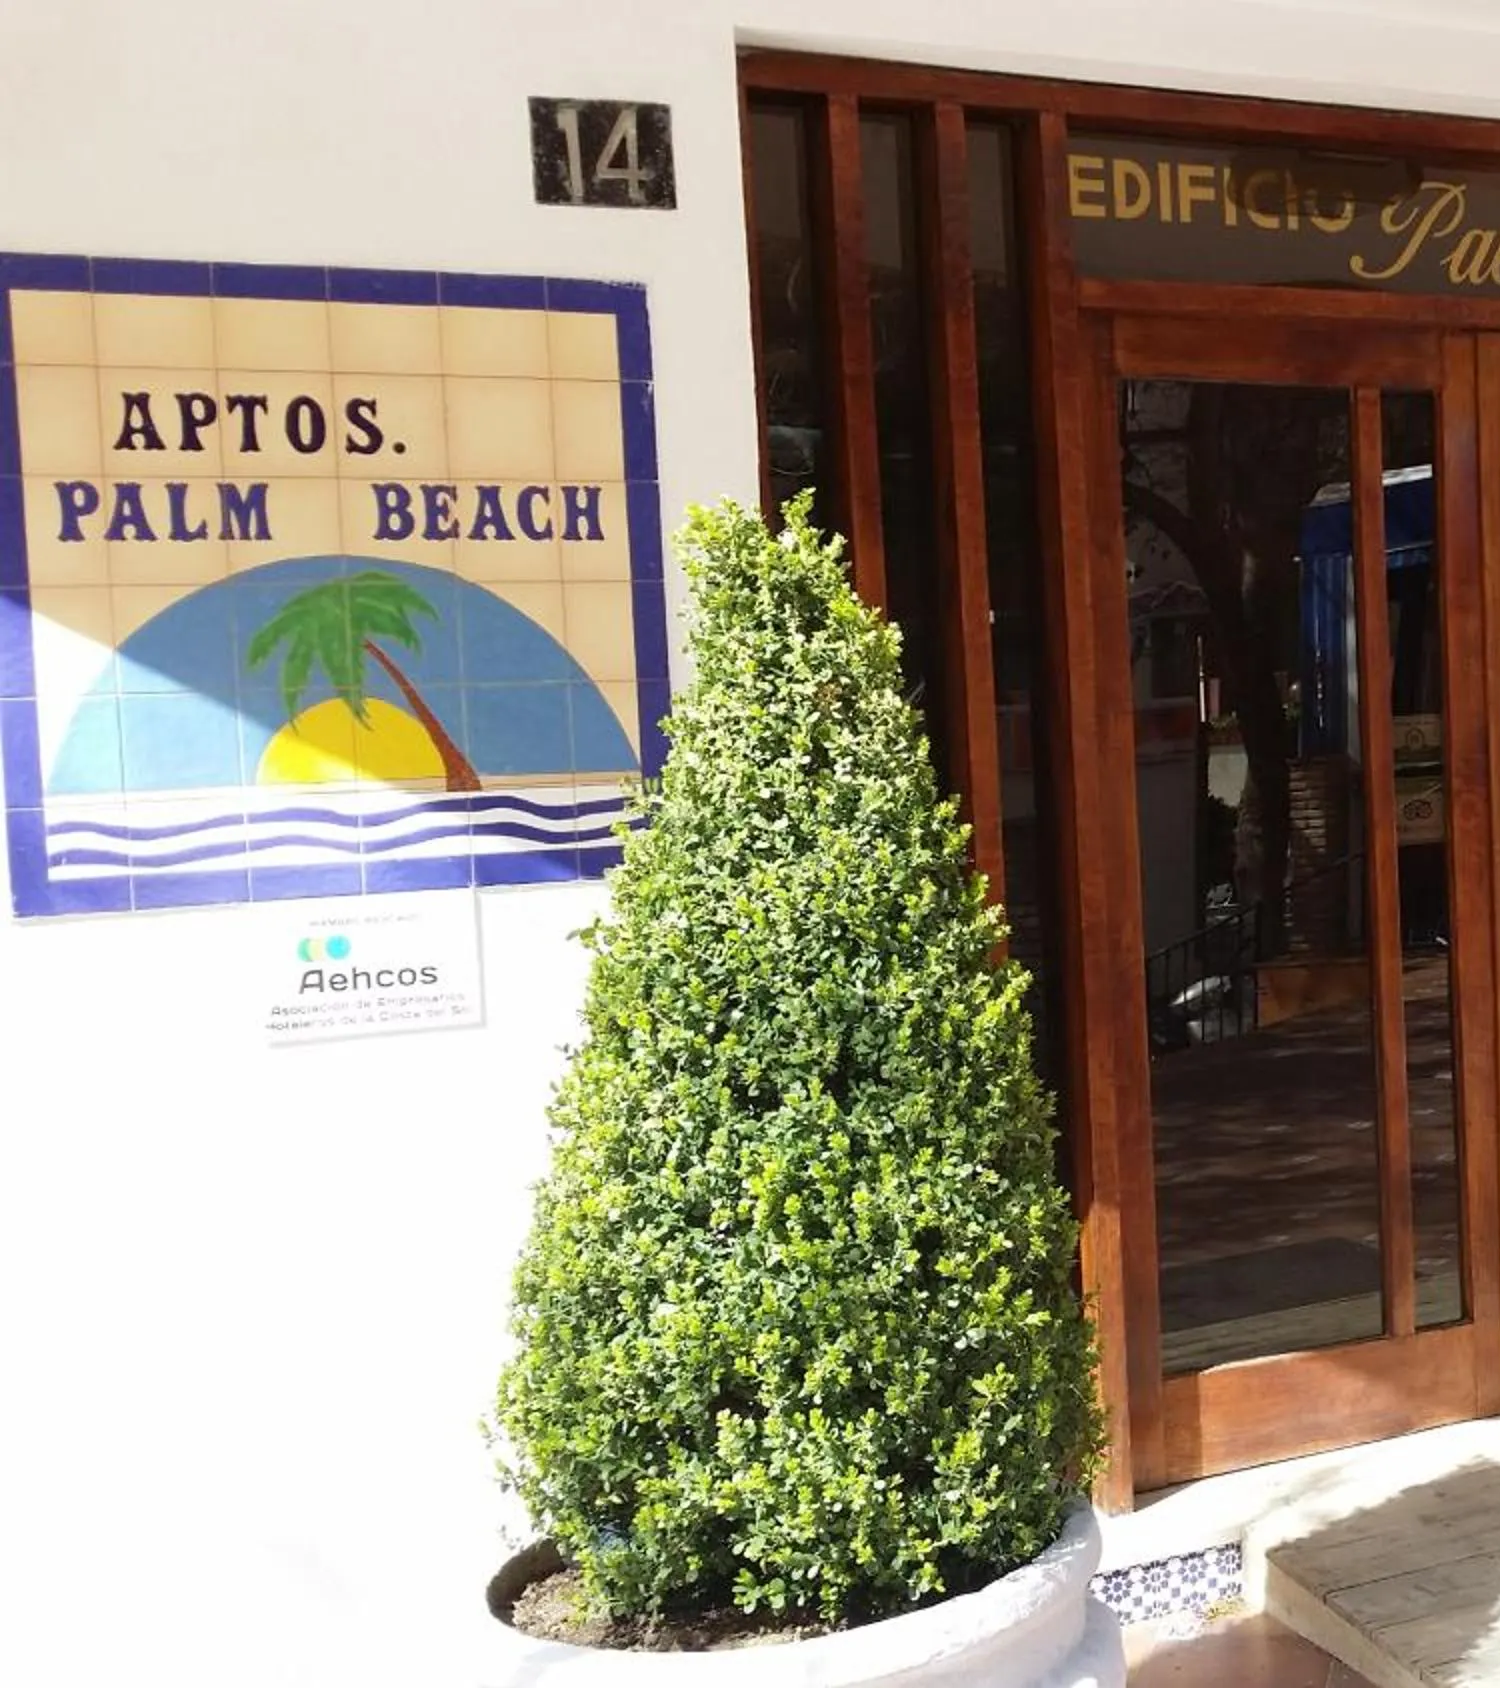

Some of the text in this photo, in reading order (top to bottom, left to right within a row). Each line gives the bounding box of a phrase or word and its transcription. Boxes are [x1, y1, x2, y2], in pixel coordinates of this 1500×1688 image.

[556, 102, 655, 204] 14
[1067, 154, 1355, 233] EDIFICIO
[113, 391, 407, 455] APTOS.
[54, 481, 605, 542] PALM BEACH
[298, 964, 438, 994] Aehcos
